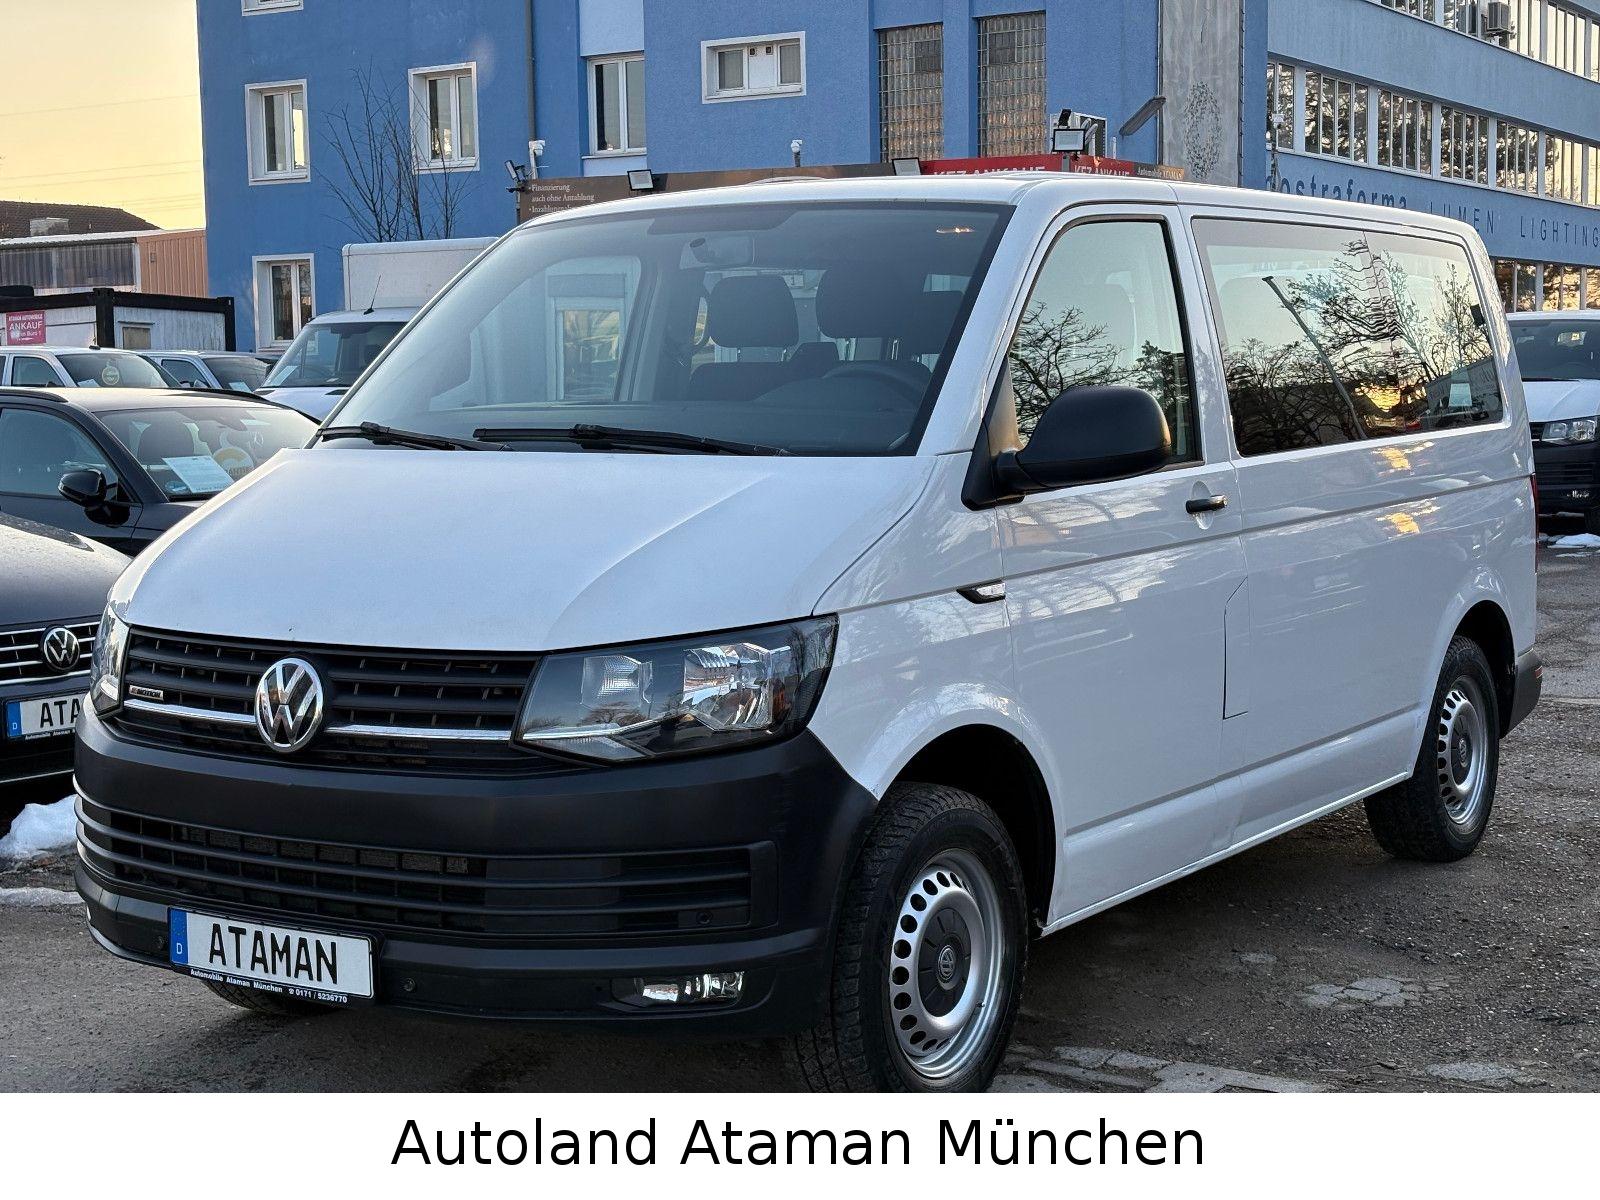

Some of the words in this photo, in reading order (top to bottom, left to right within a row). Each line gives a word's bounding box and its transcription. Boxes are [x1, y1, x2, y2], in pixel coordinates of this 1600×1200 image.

[531, 184, 570, 192] Finanzierung
[563, 193, 595, 202] Anzahlung
[1520, 216, 1600, 247] LIGHTING
[9, 321, 43, 330] ANKAUF
[12, 722, 18, 730] D
[176, 942, 183, 954] D
[209, 923, 338, 985] ATAMAN
[190, 968, 224, 982] Automobile
[226, 976, 251, 987] Ataman
[253, 981, 283, 993] München
[295, 988, 312, 998] 0171
